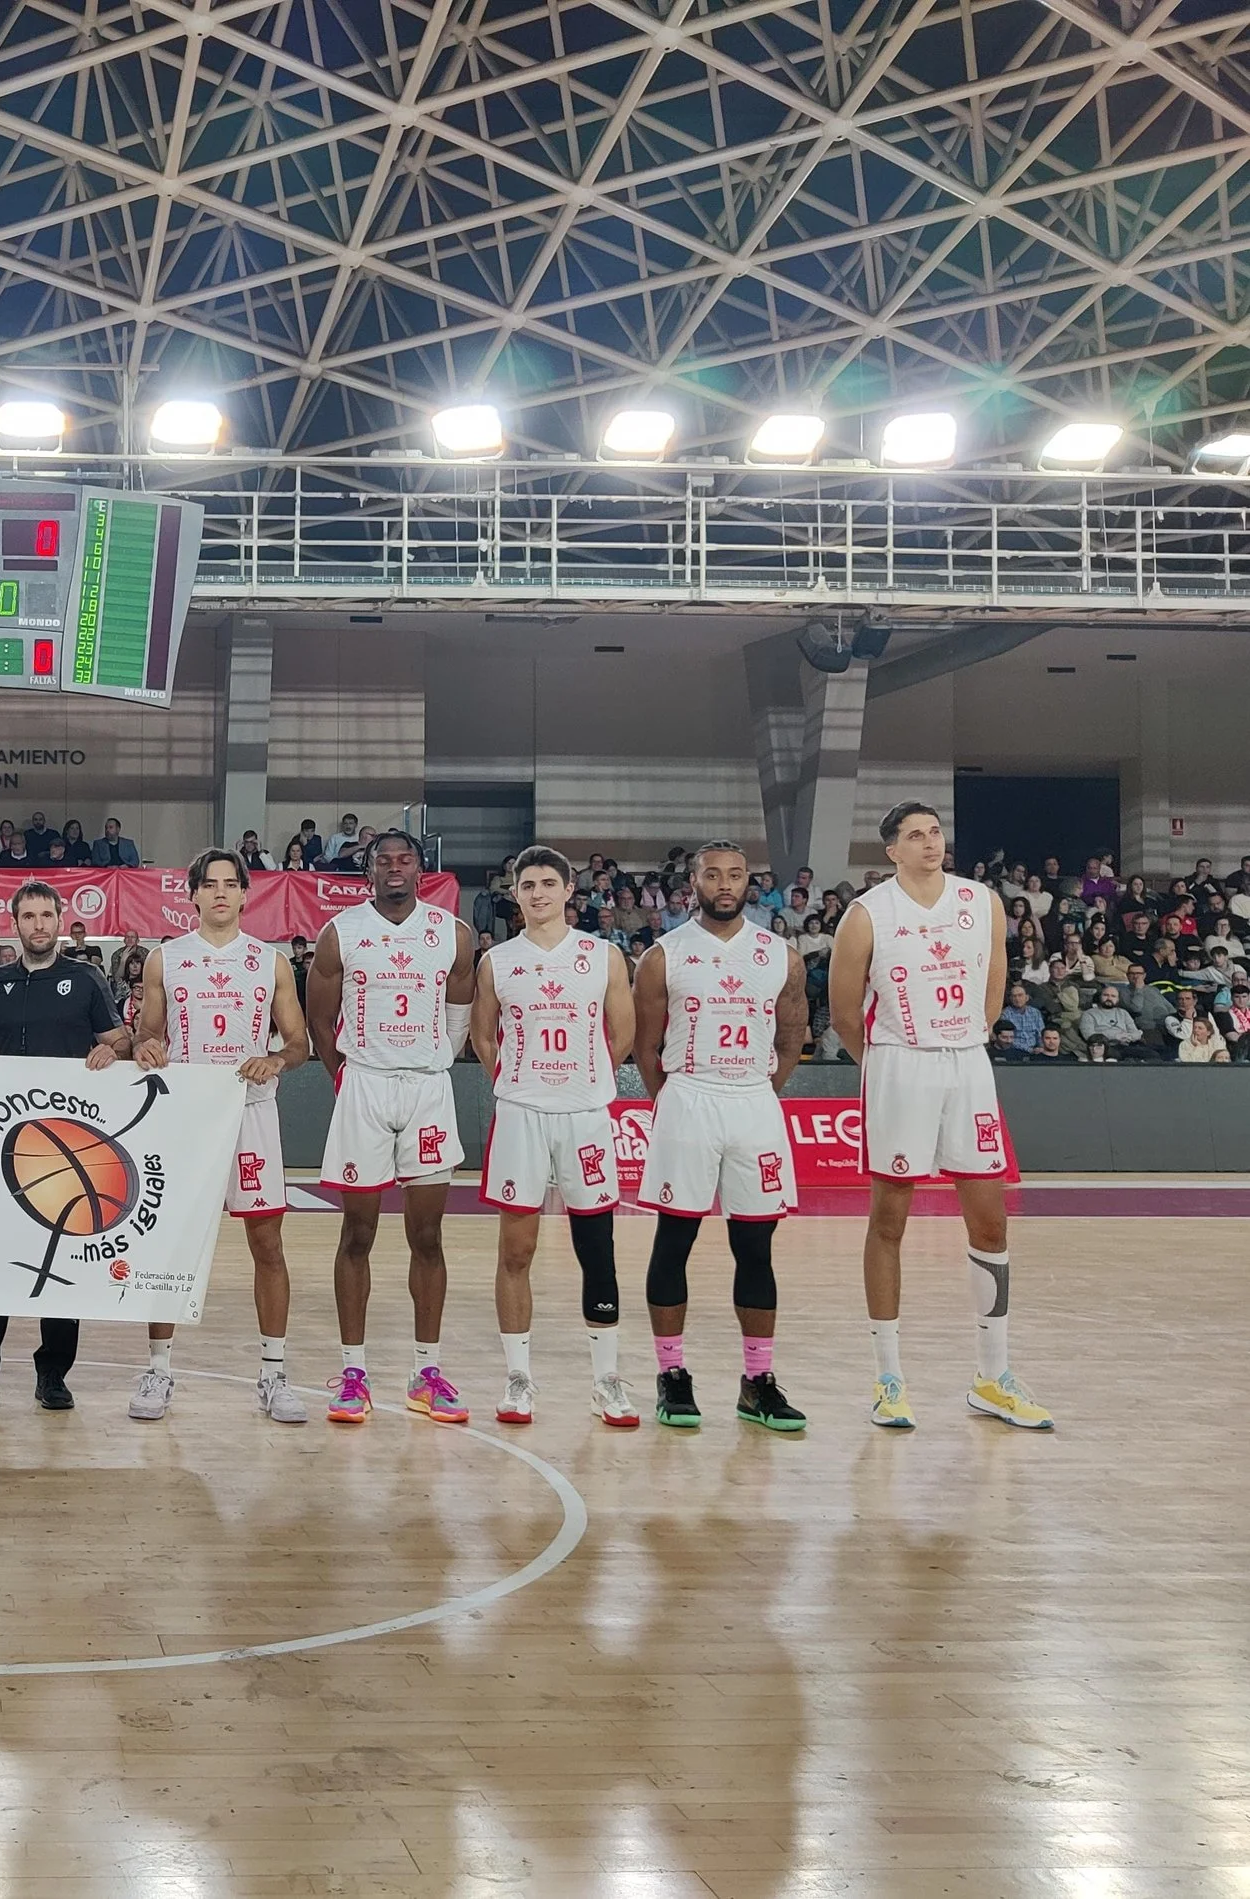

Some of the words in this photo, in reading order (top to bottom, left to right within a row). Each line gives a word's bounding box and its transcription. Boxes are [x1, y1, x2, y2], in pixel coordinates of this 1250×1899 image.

[99, 500, 107, 512] E
[96, 514, 105, 527] 3
[95, 528, 104, 541] 4
[93, 542, 102, 555] 6
[85, 556, 101, 570] 10
[83, 570, 100, 583] 11
[82, 585, 99, 598] 12
[81, 599, 98, 612] 18
[18, 618, 60, 627] MONDO
[80, 613, 96, 627] 20
[78, 627, 95, 641] 22
[77, 641, 94, 655] 23
[34, 641, 53, 673] 0
[76, 656, 92, 669] 24
[29, 676, 57, 685] FALTAS
[75, 670, 91, 684] 33
[124, 688, 166, 699] MONDO
[936, 984, 964, 1011] 99
[395, 994, 408, 1017] 3
[213, 1014, 226, 1037] 9
[379, 1022, 425, 1033] Ezedent
[540, 1028, 567, 1052] 10
[719, 1024, 749, 1049] 24
[203, 1044, 245, 1053] Ezedent
[532, 1060, 578, 1071] Ezedent
[710, 1055, 756, 1065] Ezedent
[129, 1153, 165, 1236] iguales
[135, 1271, 175, 1281] Federación
[177, 1273, 185, 1281] de
[135, 1282, 143, 1290] de
[145, 1282, 173, 1291] Castilla
